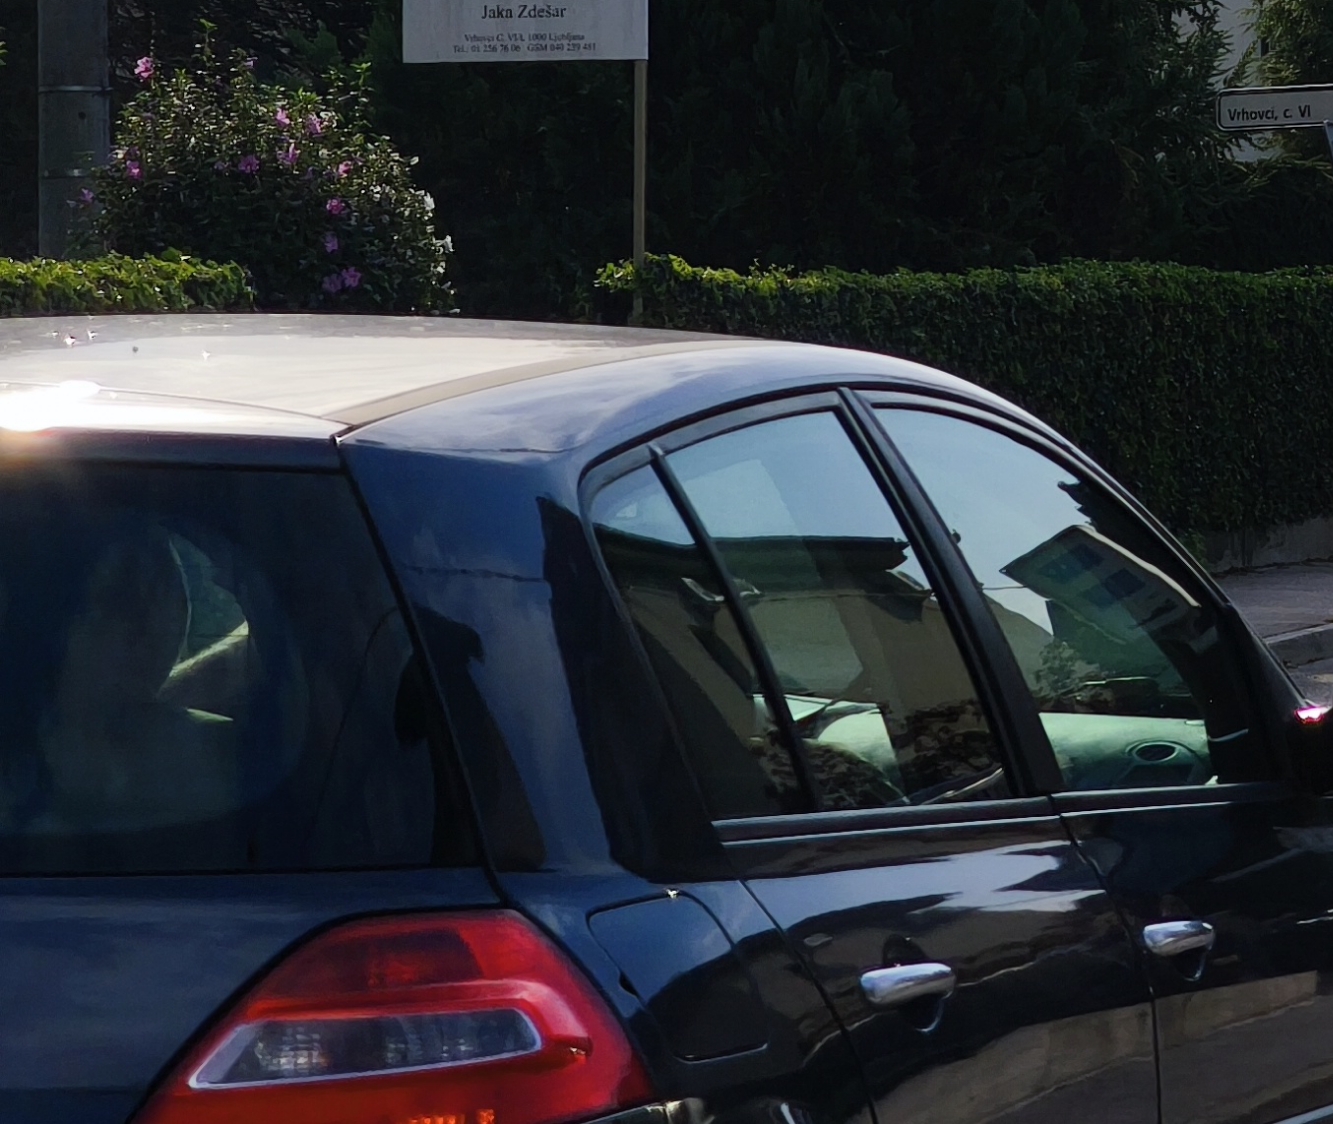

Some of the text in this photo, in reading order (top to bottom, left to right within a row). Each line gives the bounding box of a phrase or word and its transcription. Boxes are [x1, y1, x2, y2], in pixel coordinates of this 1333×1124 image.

[481, 4, 567, 20] Jaka Zdešar
[528, 33, 547, 42] 1000
[1228, 106, 1279, 122] Vrhovci,
[1298, 105, 1311, 118] VI
